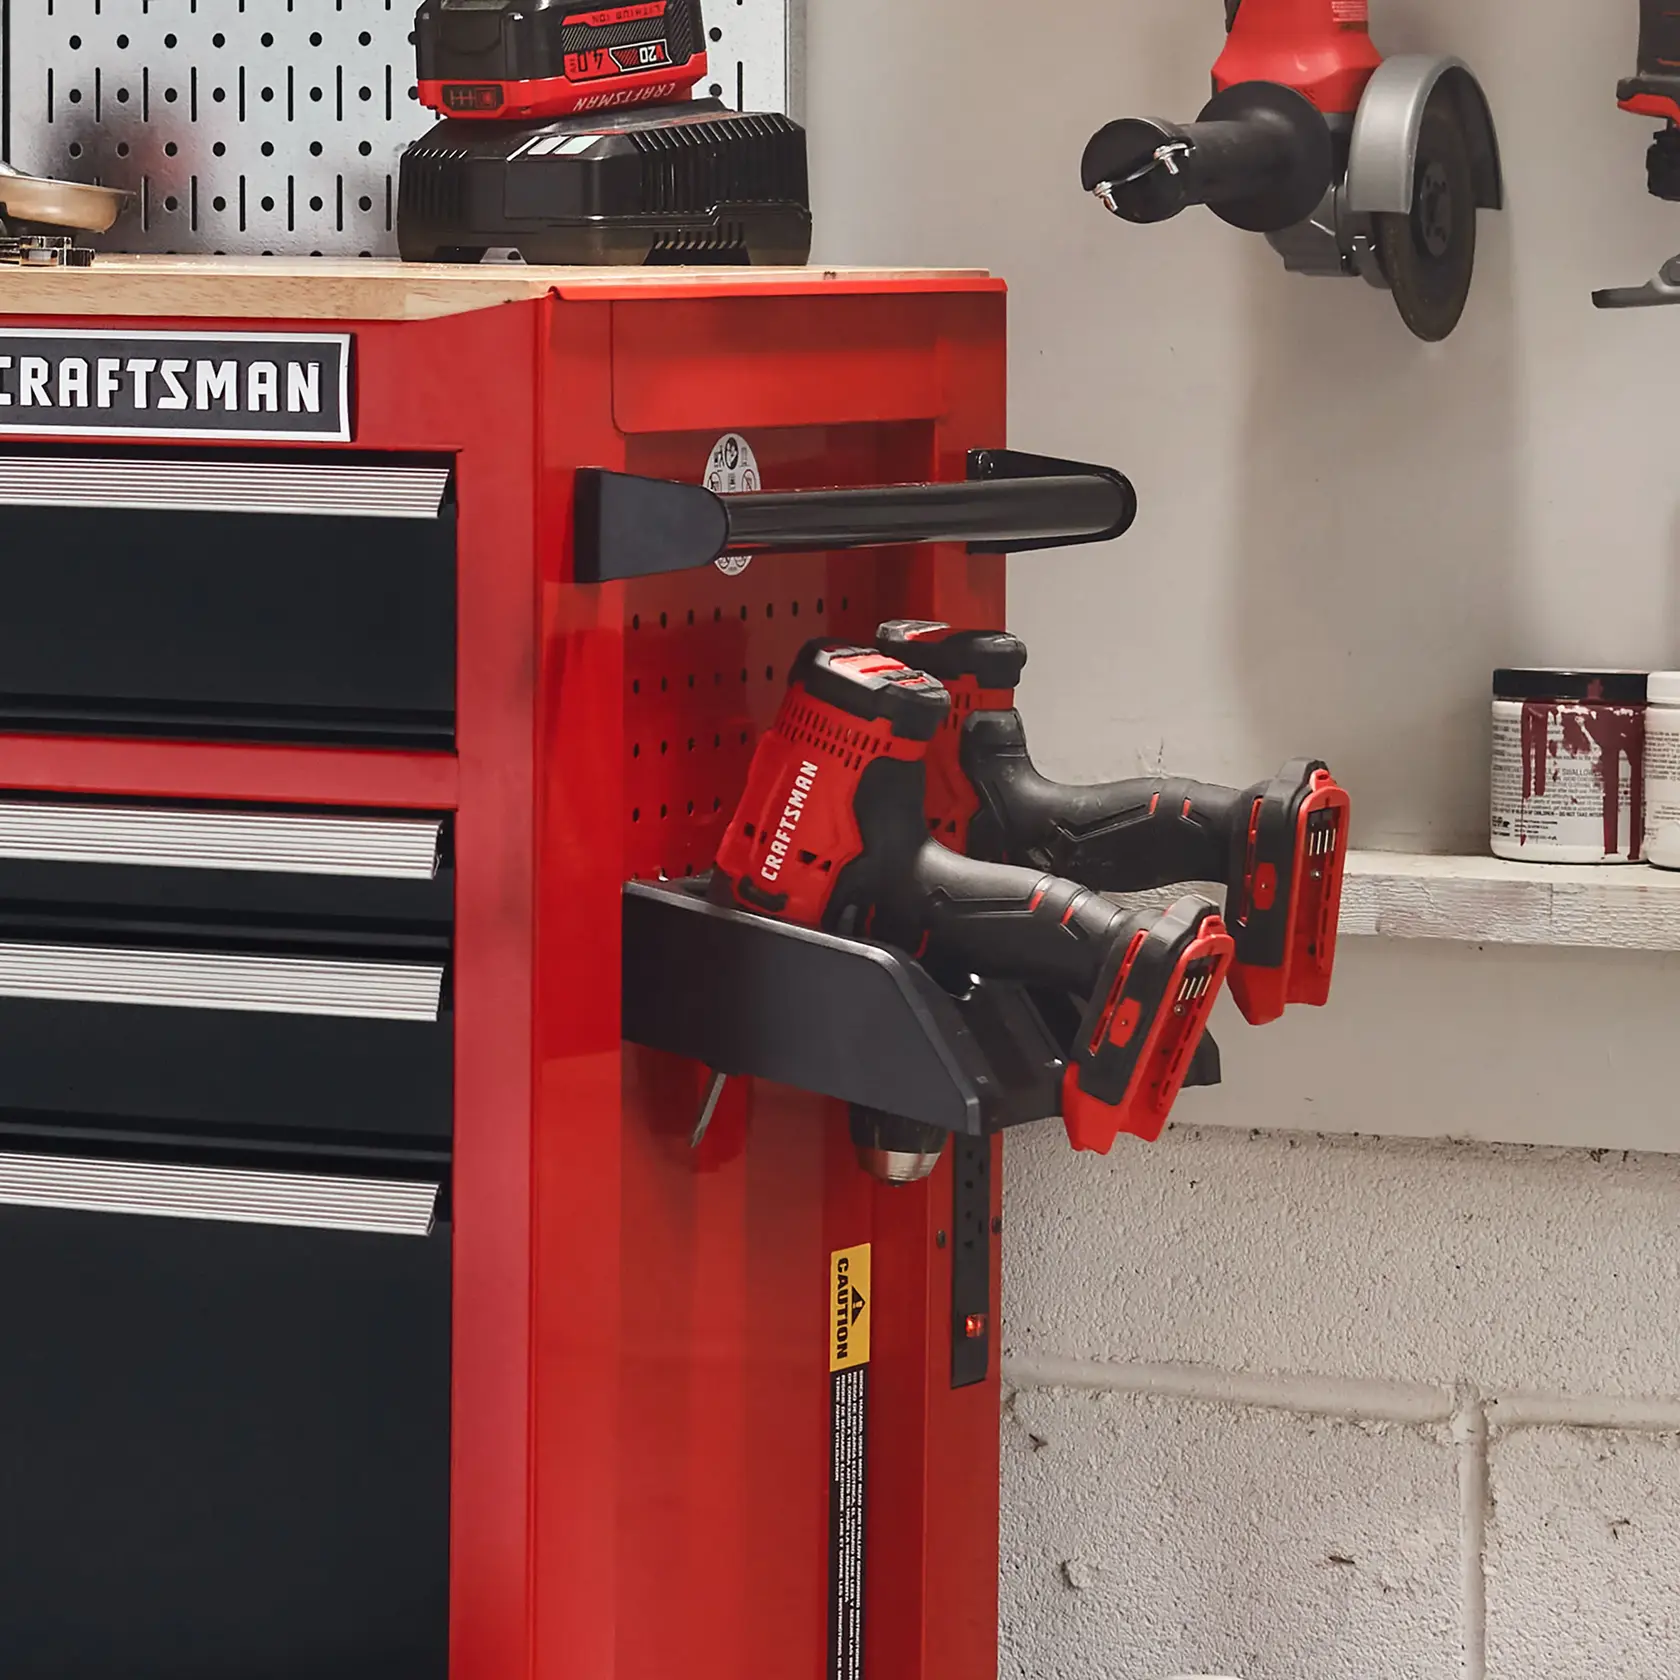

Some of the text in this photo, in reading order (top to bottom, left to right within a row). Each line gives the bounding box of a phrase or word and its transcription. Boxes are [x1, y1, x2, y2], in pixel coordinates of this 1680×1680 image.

[572, 82, 676, 112] CRAFTSMAN
[761, 760, 818, 882] CRAFTSMAN
[836, 1258, 848, 1360] CAUTION
